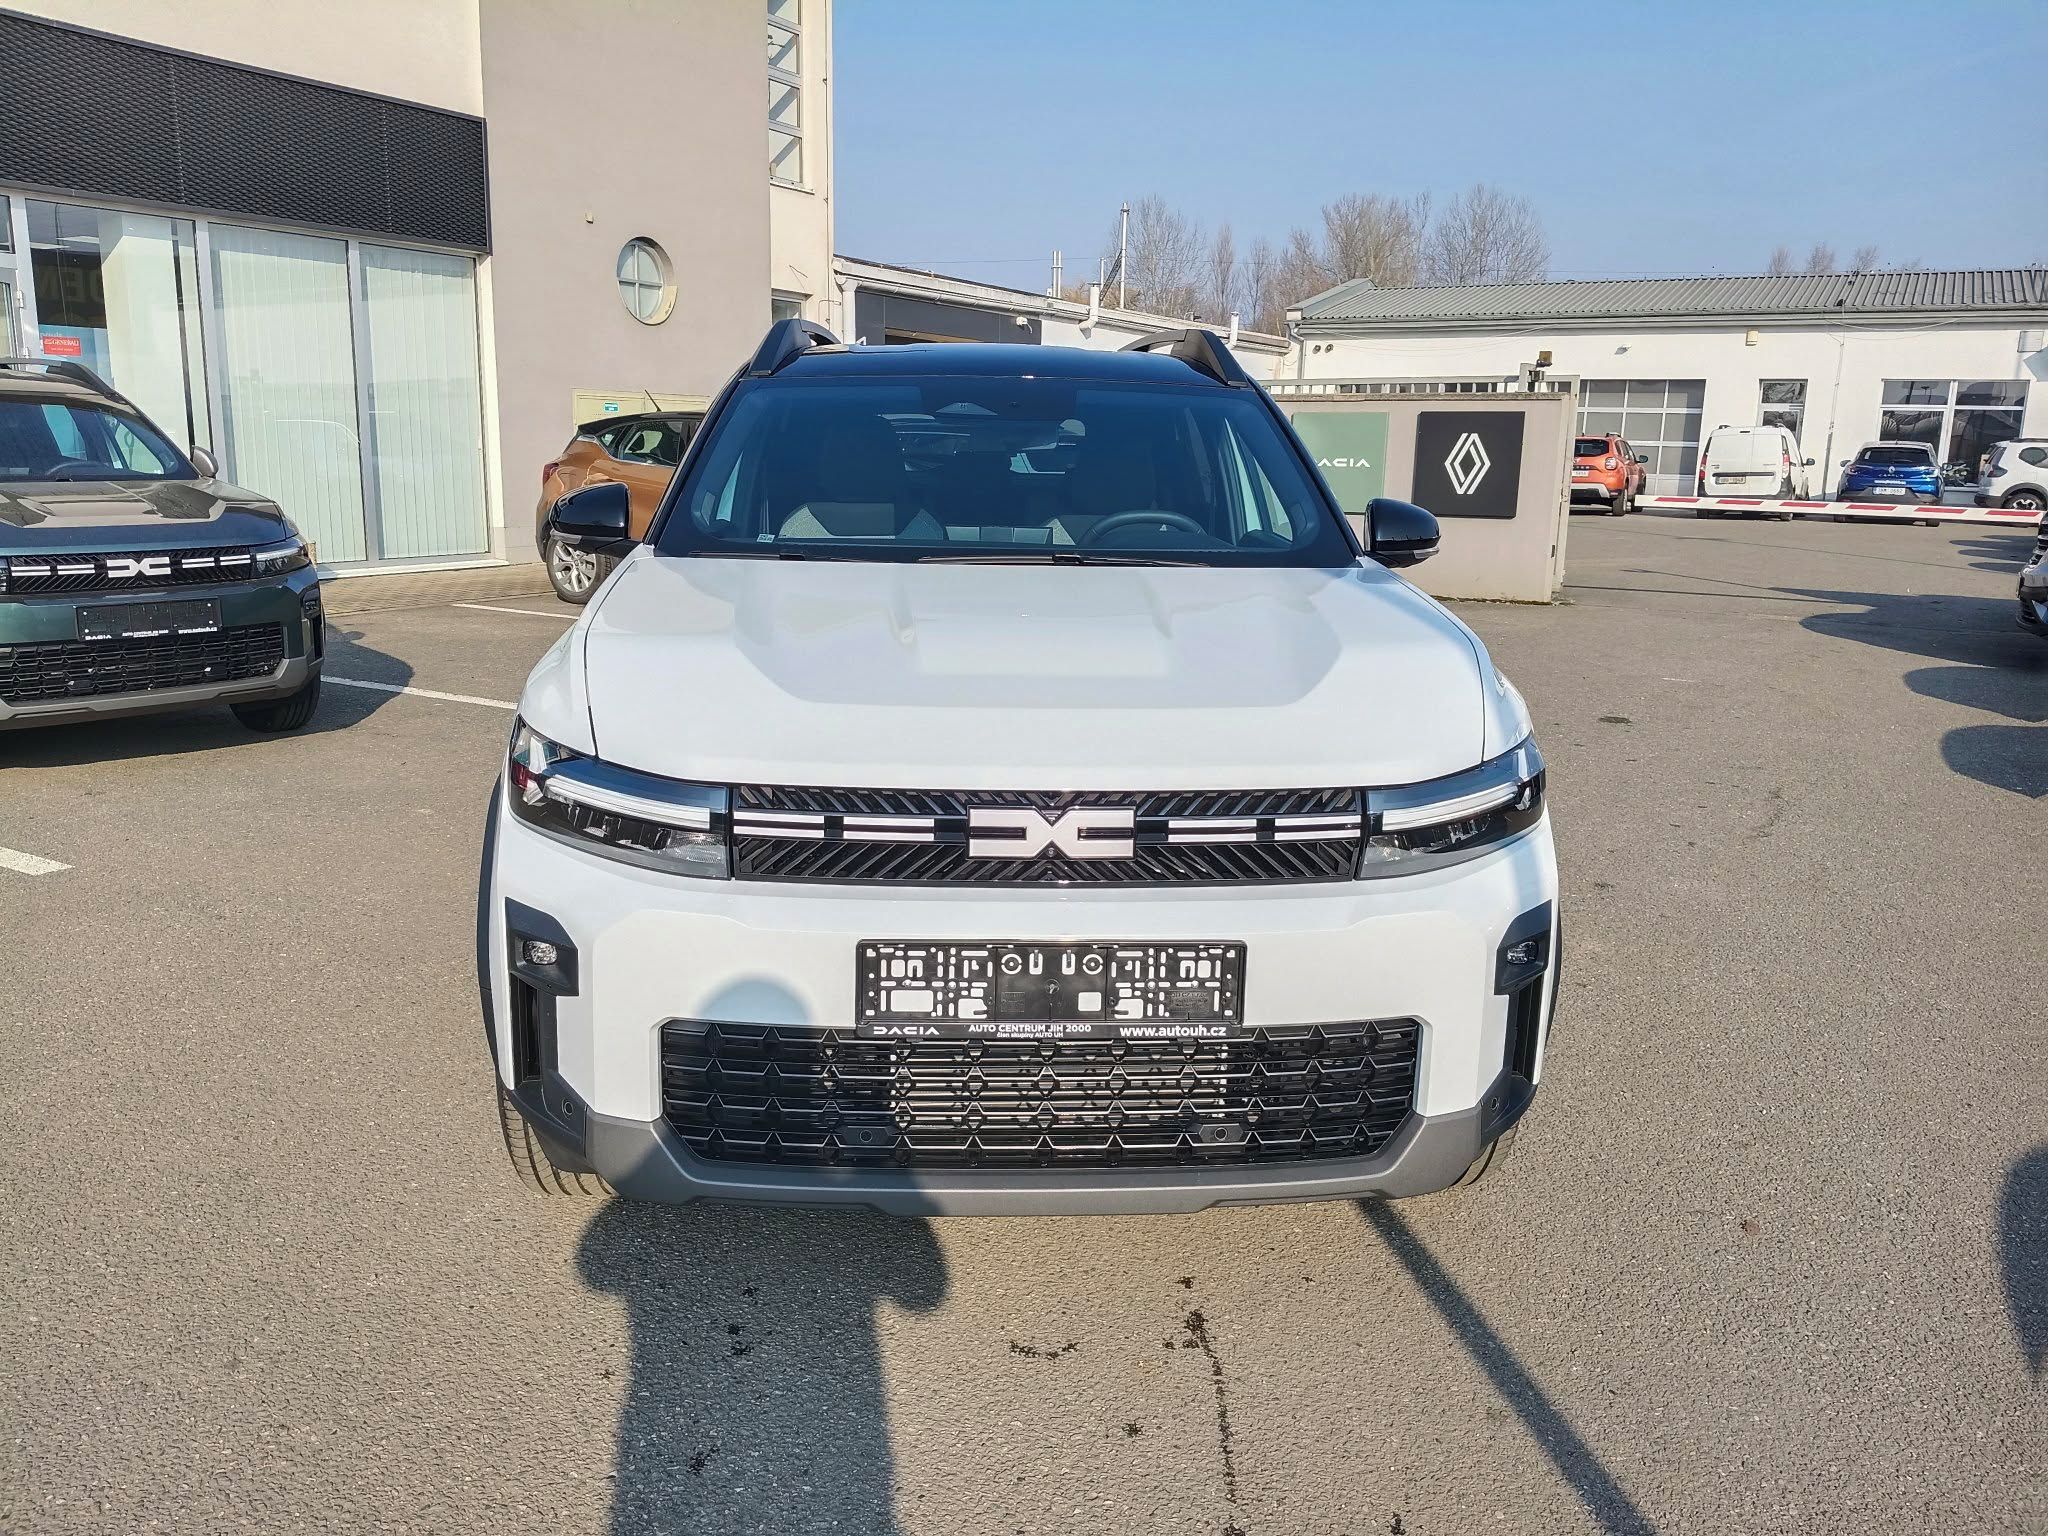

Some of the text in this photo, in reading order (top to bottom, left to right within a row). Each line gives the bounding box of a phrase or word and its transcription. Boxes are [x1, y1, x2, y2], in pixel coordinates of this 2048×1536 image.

[1315, 457, 1371, 468] ACIA
[873, 1026, 940, 1036] DACIA
[968, 1024, 1092, 1033] AUTO CENTRUM JIH 2000
[1119, 1024, 1227, 1037] www.autouh.cz
[1012, 1031, 1034, 1039] skupiny
